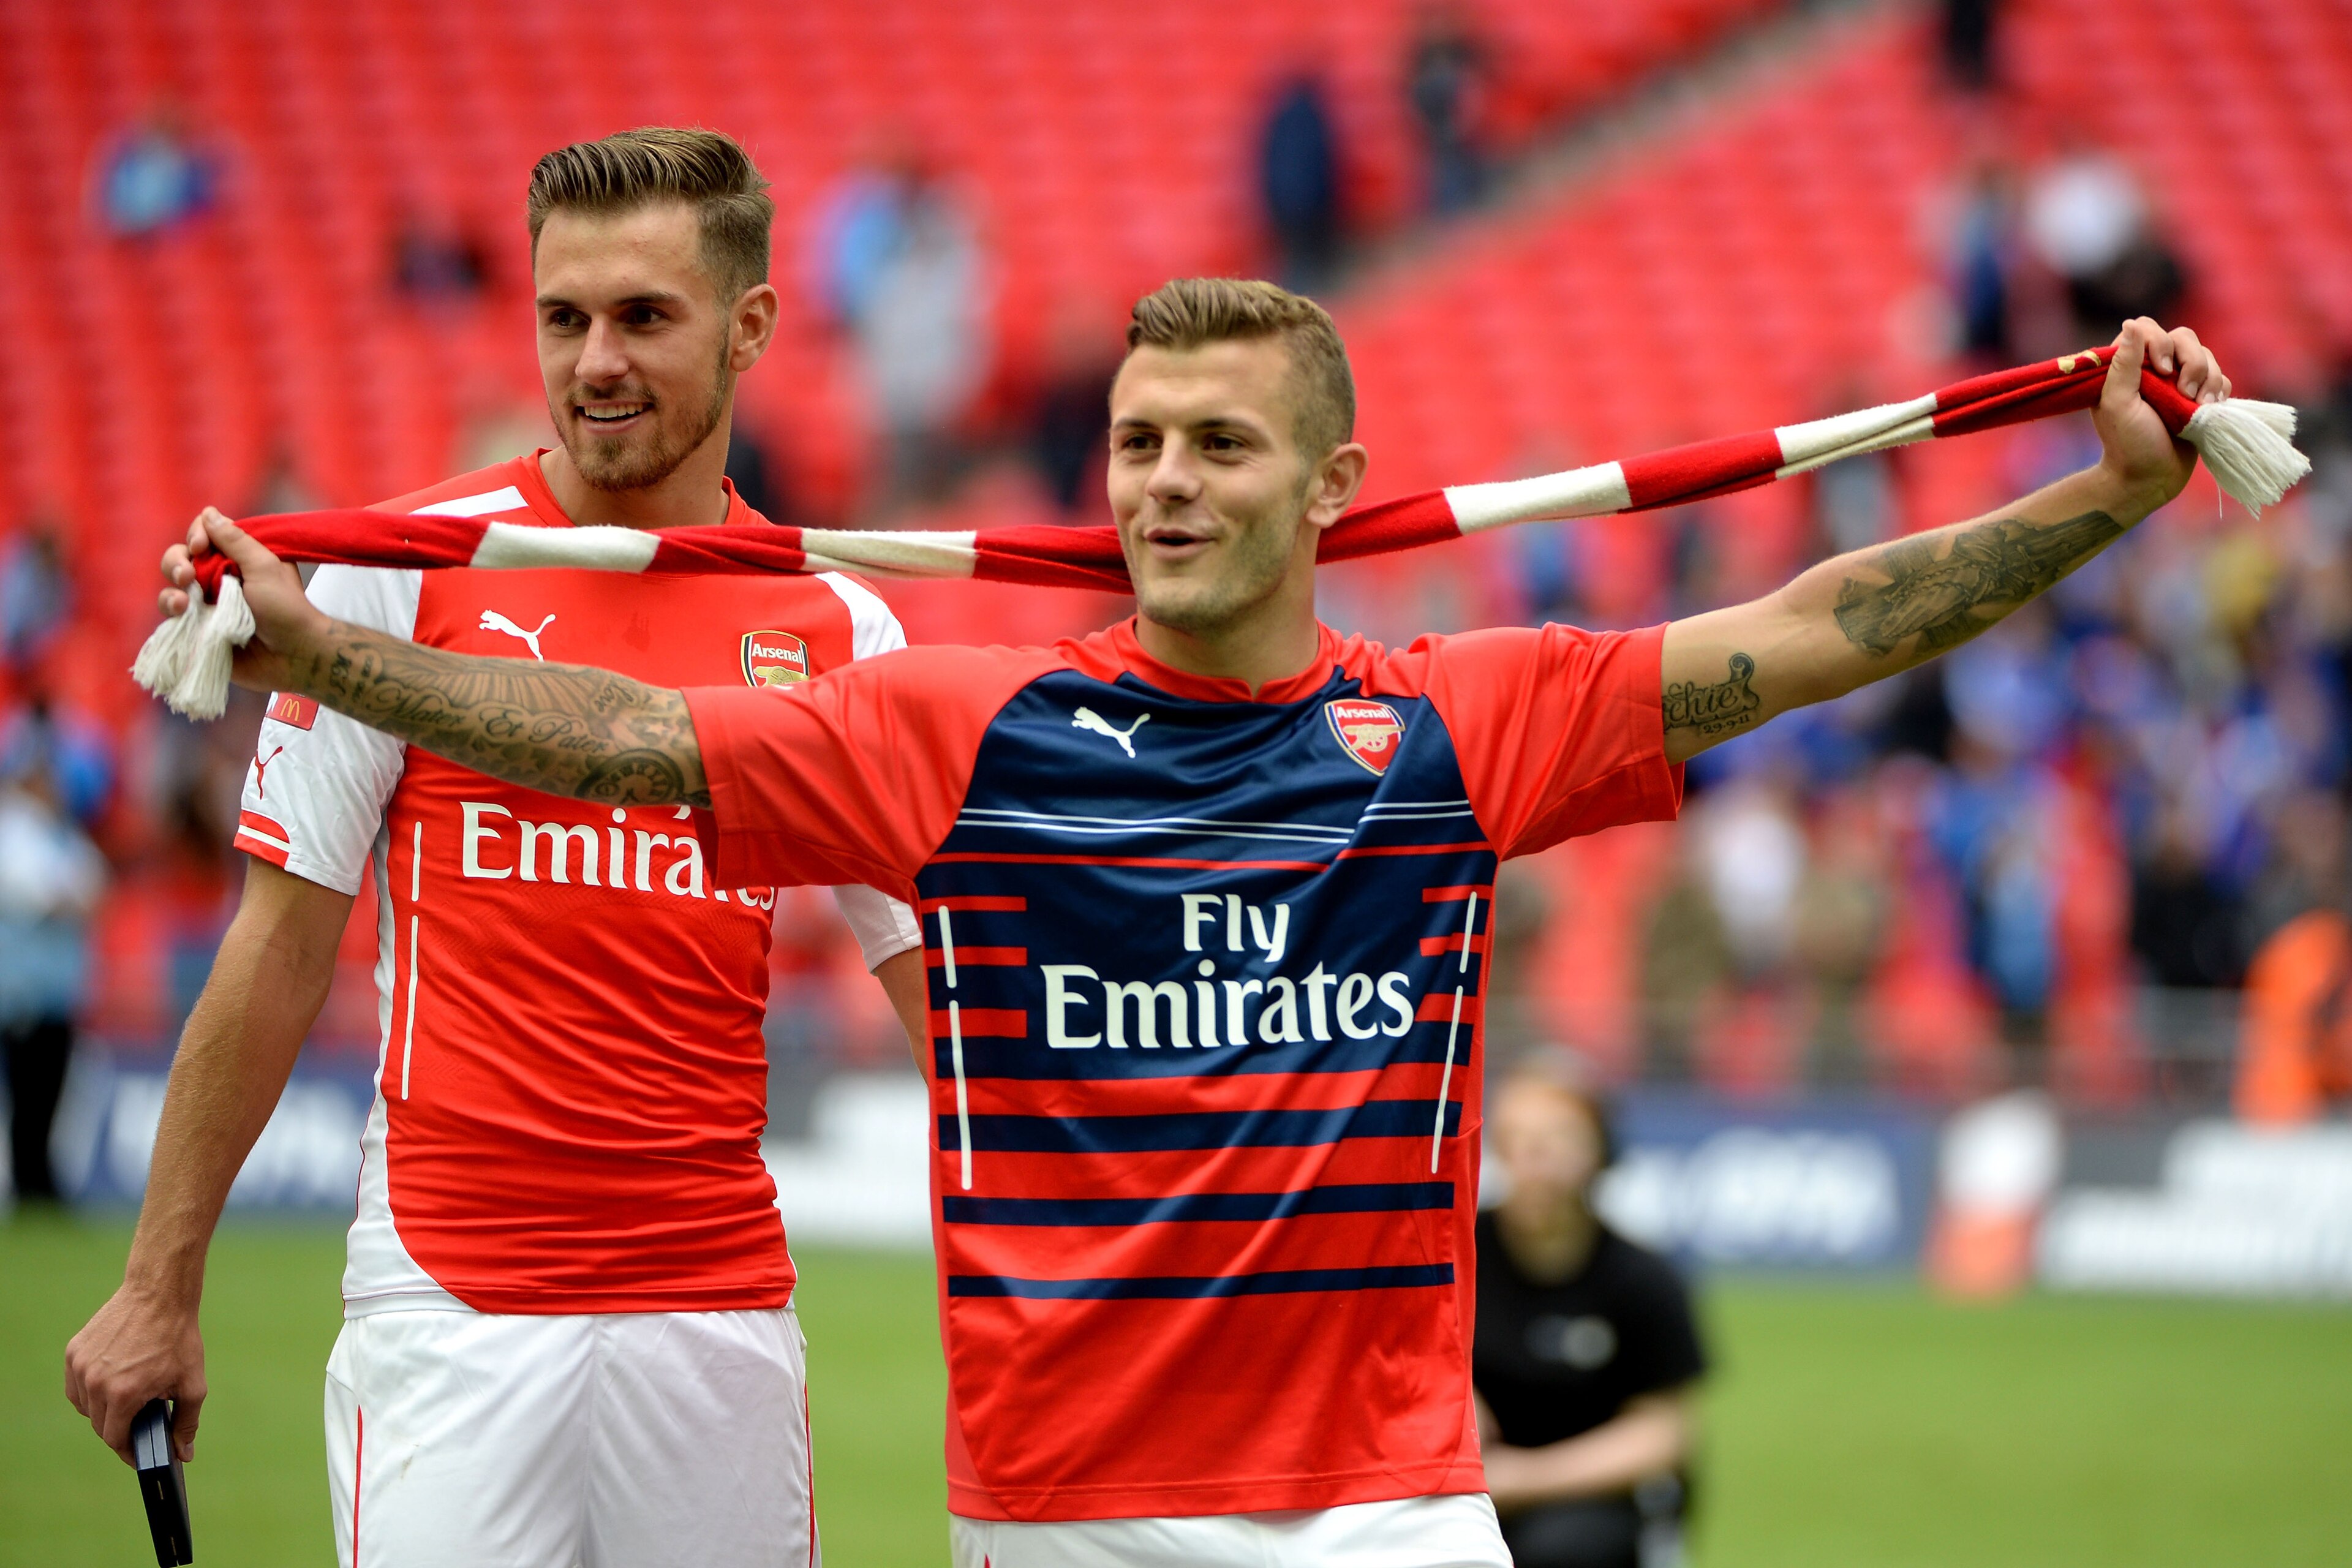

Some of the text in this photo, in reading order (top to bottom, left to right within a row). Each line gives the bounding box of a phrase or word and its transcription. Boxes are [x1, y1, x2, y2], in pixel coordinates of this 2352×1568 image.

[752, 643, 803, 663] Arsenal
[366, 687, 609, 753] Mater Et Pater
[1336, 706, 1390, 718] Arsenal
[1662, 680, 1738, 722] chie
[459, 801, 776, 911] Emira
[1180, 894, 1290, 963] Fly
[1039, 960, 1415, 1049] Emirates
